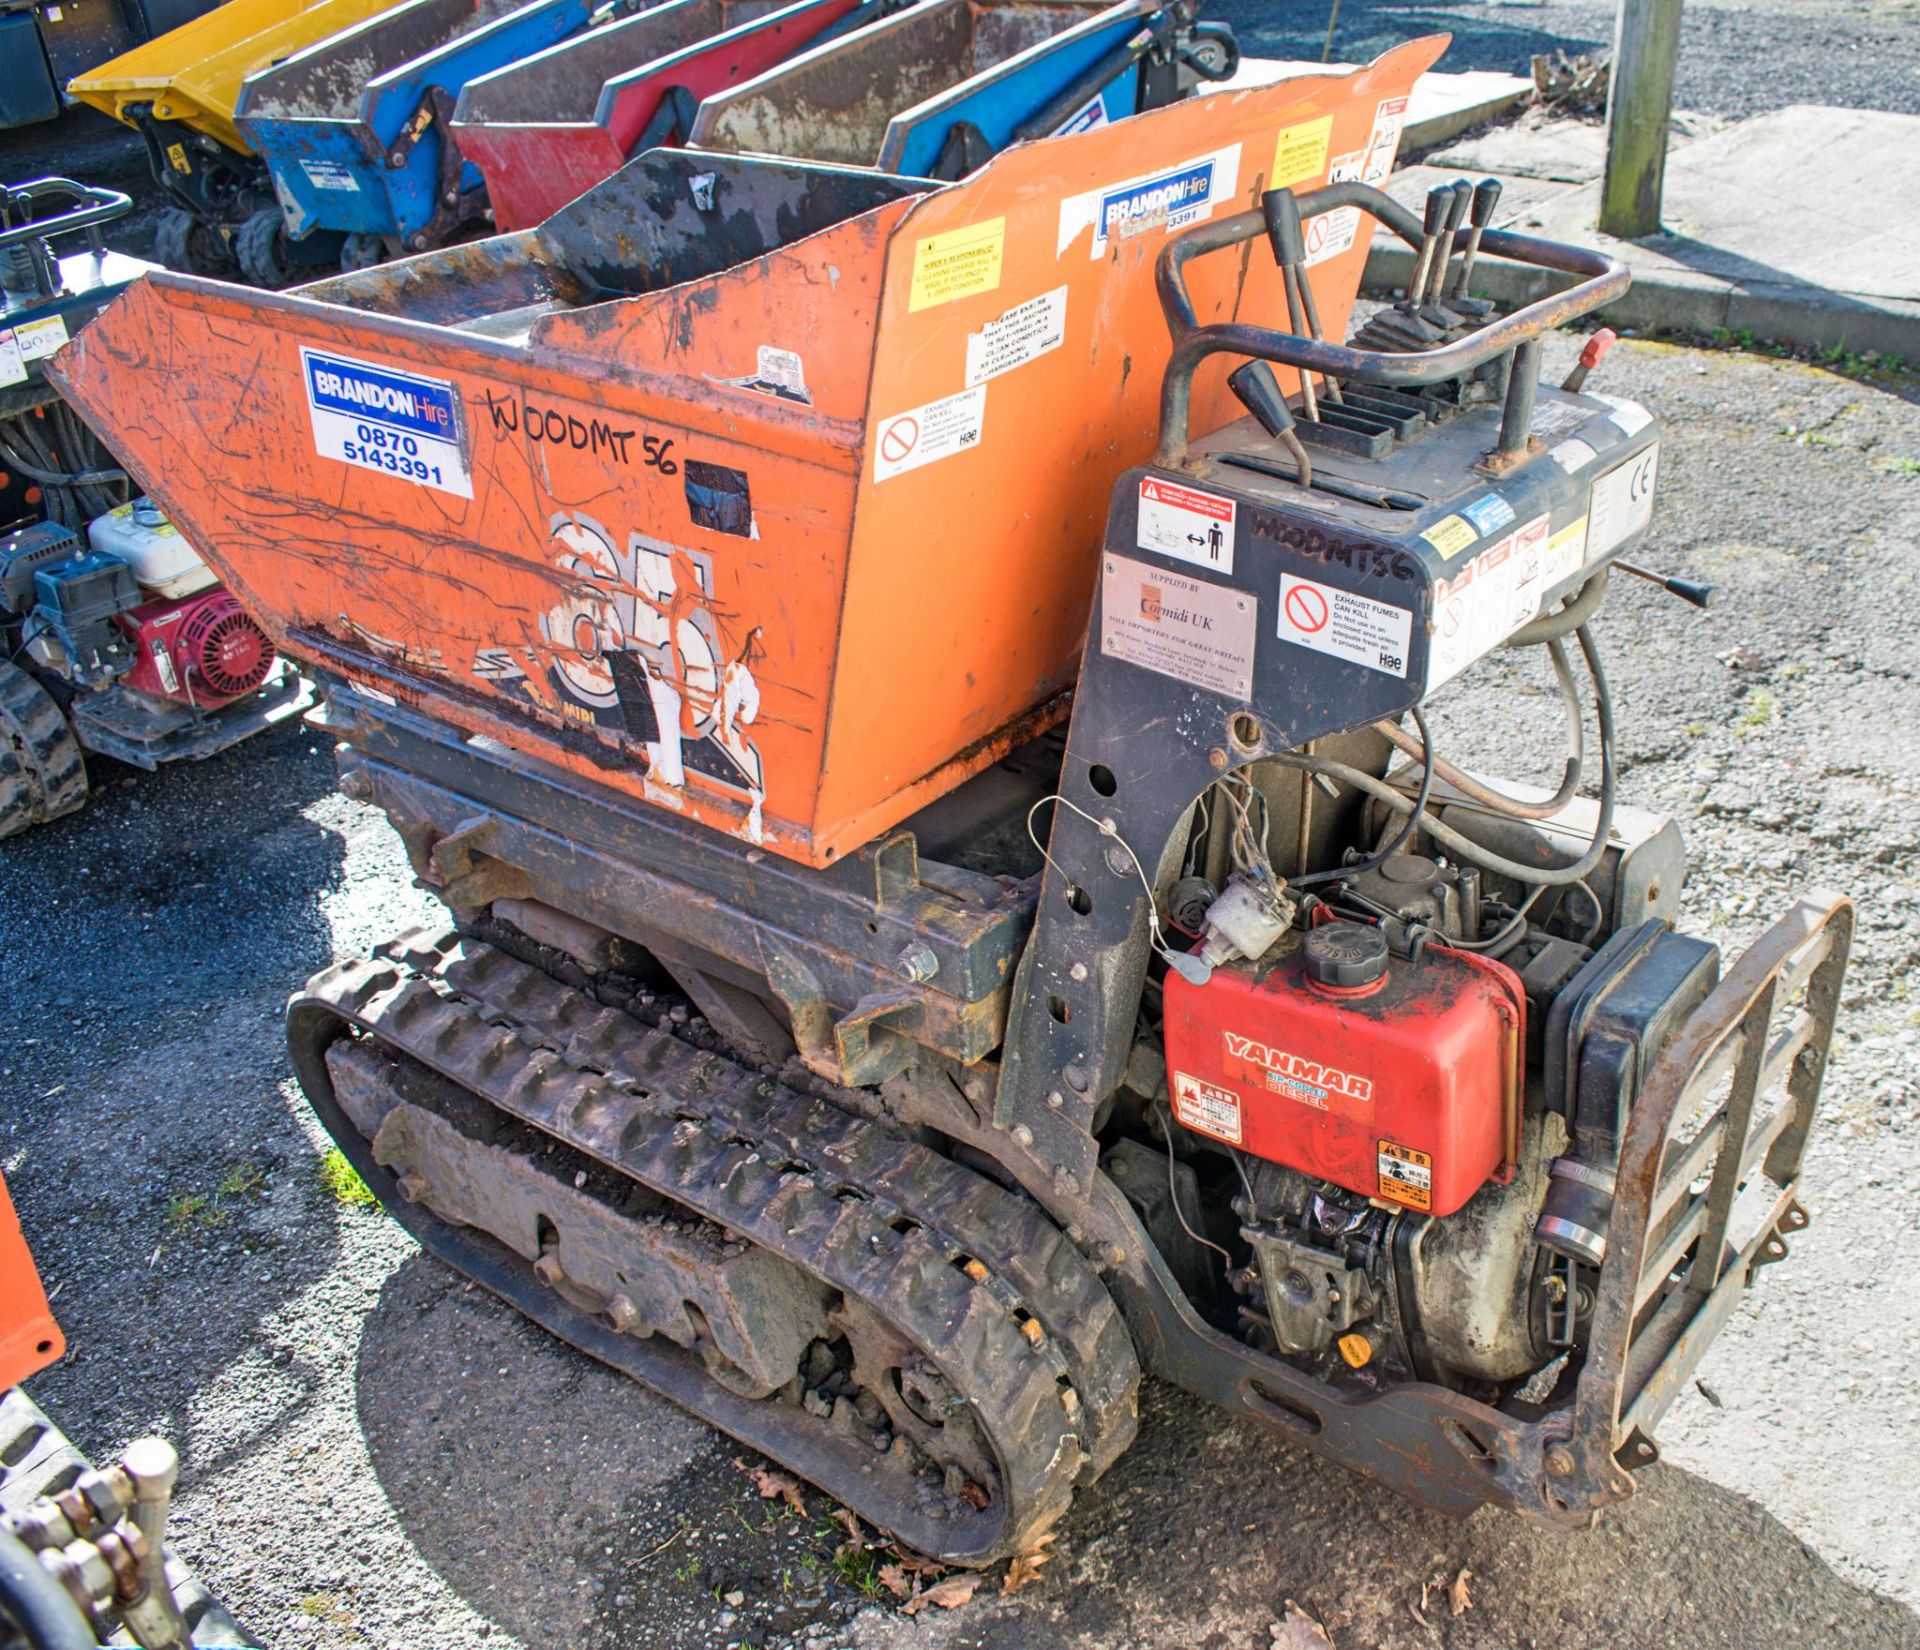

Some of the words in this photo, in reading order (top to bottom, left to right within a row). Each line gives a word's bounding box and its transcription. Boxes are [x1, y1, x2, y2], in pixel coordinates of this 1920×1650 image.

[1106, 182, 1185, 225] BRANDON
[1184, 175, 1208, 201] Hire
[984, 326, 1001, 339] THAT
[314, 370, 414, 418] BRANDON
[412, 395, 449, 426] Hire
[357, 424, 418, 456] 0870
[486, 388, 635, 464] WOODMT
[643, 436, 678, 475] 56
[343, 441, 442, 485] 5143391
[1149, 571, 1187, 589] SUPPLIED
[1189, 583, 1200, 593] BY
[1140, 594, 1188, 629] Cormidi
[1191, 612, 1213, 632] UK
[1333, 612, 1343, 620] Do
[1344, 615, 1355, 624] Not
[1356, 620, 1368, 628] use
[1334, 594, 1369, 611] EXHAUST
[1371, 605, 1400, 619] FUMES
[1334, 603, 1350, 614] CAN
[1352, 608, 1368, 619] KILL
[1128, 621, 1169, 639] IMPORTERS
[1171, 635, 1186, 645] FOR
[1188, 640, 1211, 653] GREAT
[1214, 648, 1245, 664] BRITAIN
[1332, 621, 1361, 634] enclosed
[1362, 631, 1376, 639] area
[1378, 635, 1398, 646] unless
[1332, 629, 1360, 643] adequate
[1362, 638, 1379, 648] fresh
[1338, 638, 1367, 654] provided.
[1224, 1031, 1373, 1101] YANMAR
[1266, 1070, 1328, 1099] AIR-COOLED
[1266, 1080, 1329, 1111] DIESEL
